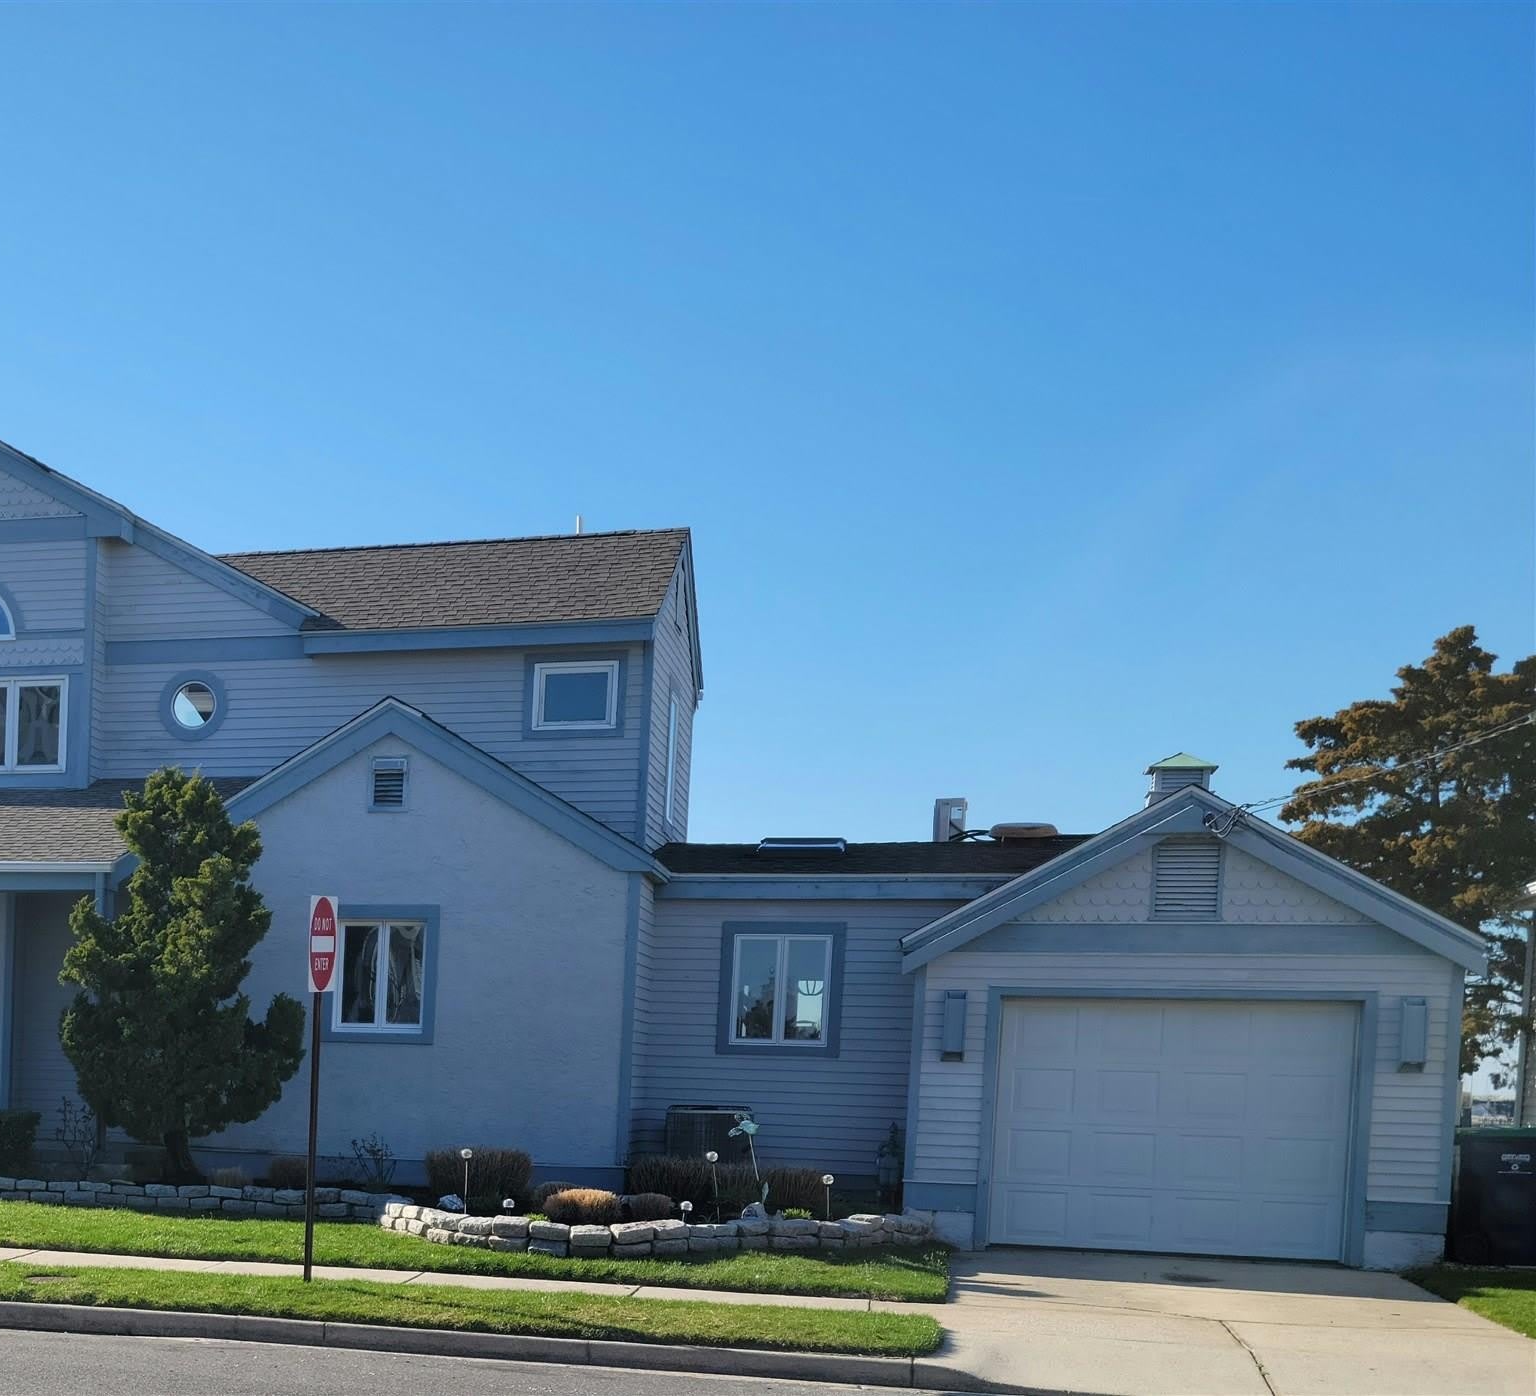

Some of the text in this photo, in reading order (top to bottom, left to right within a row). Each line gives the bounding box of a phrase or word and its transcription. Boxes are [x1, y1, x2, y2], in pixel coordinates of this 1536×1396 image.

[314, 917, 332, 931] DO NOT
[314, 957, 329, 971] ENTER
